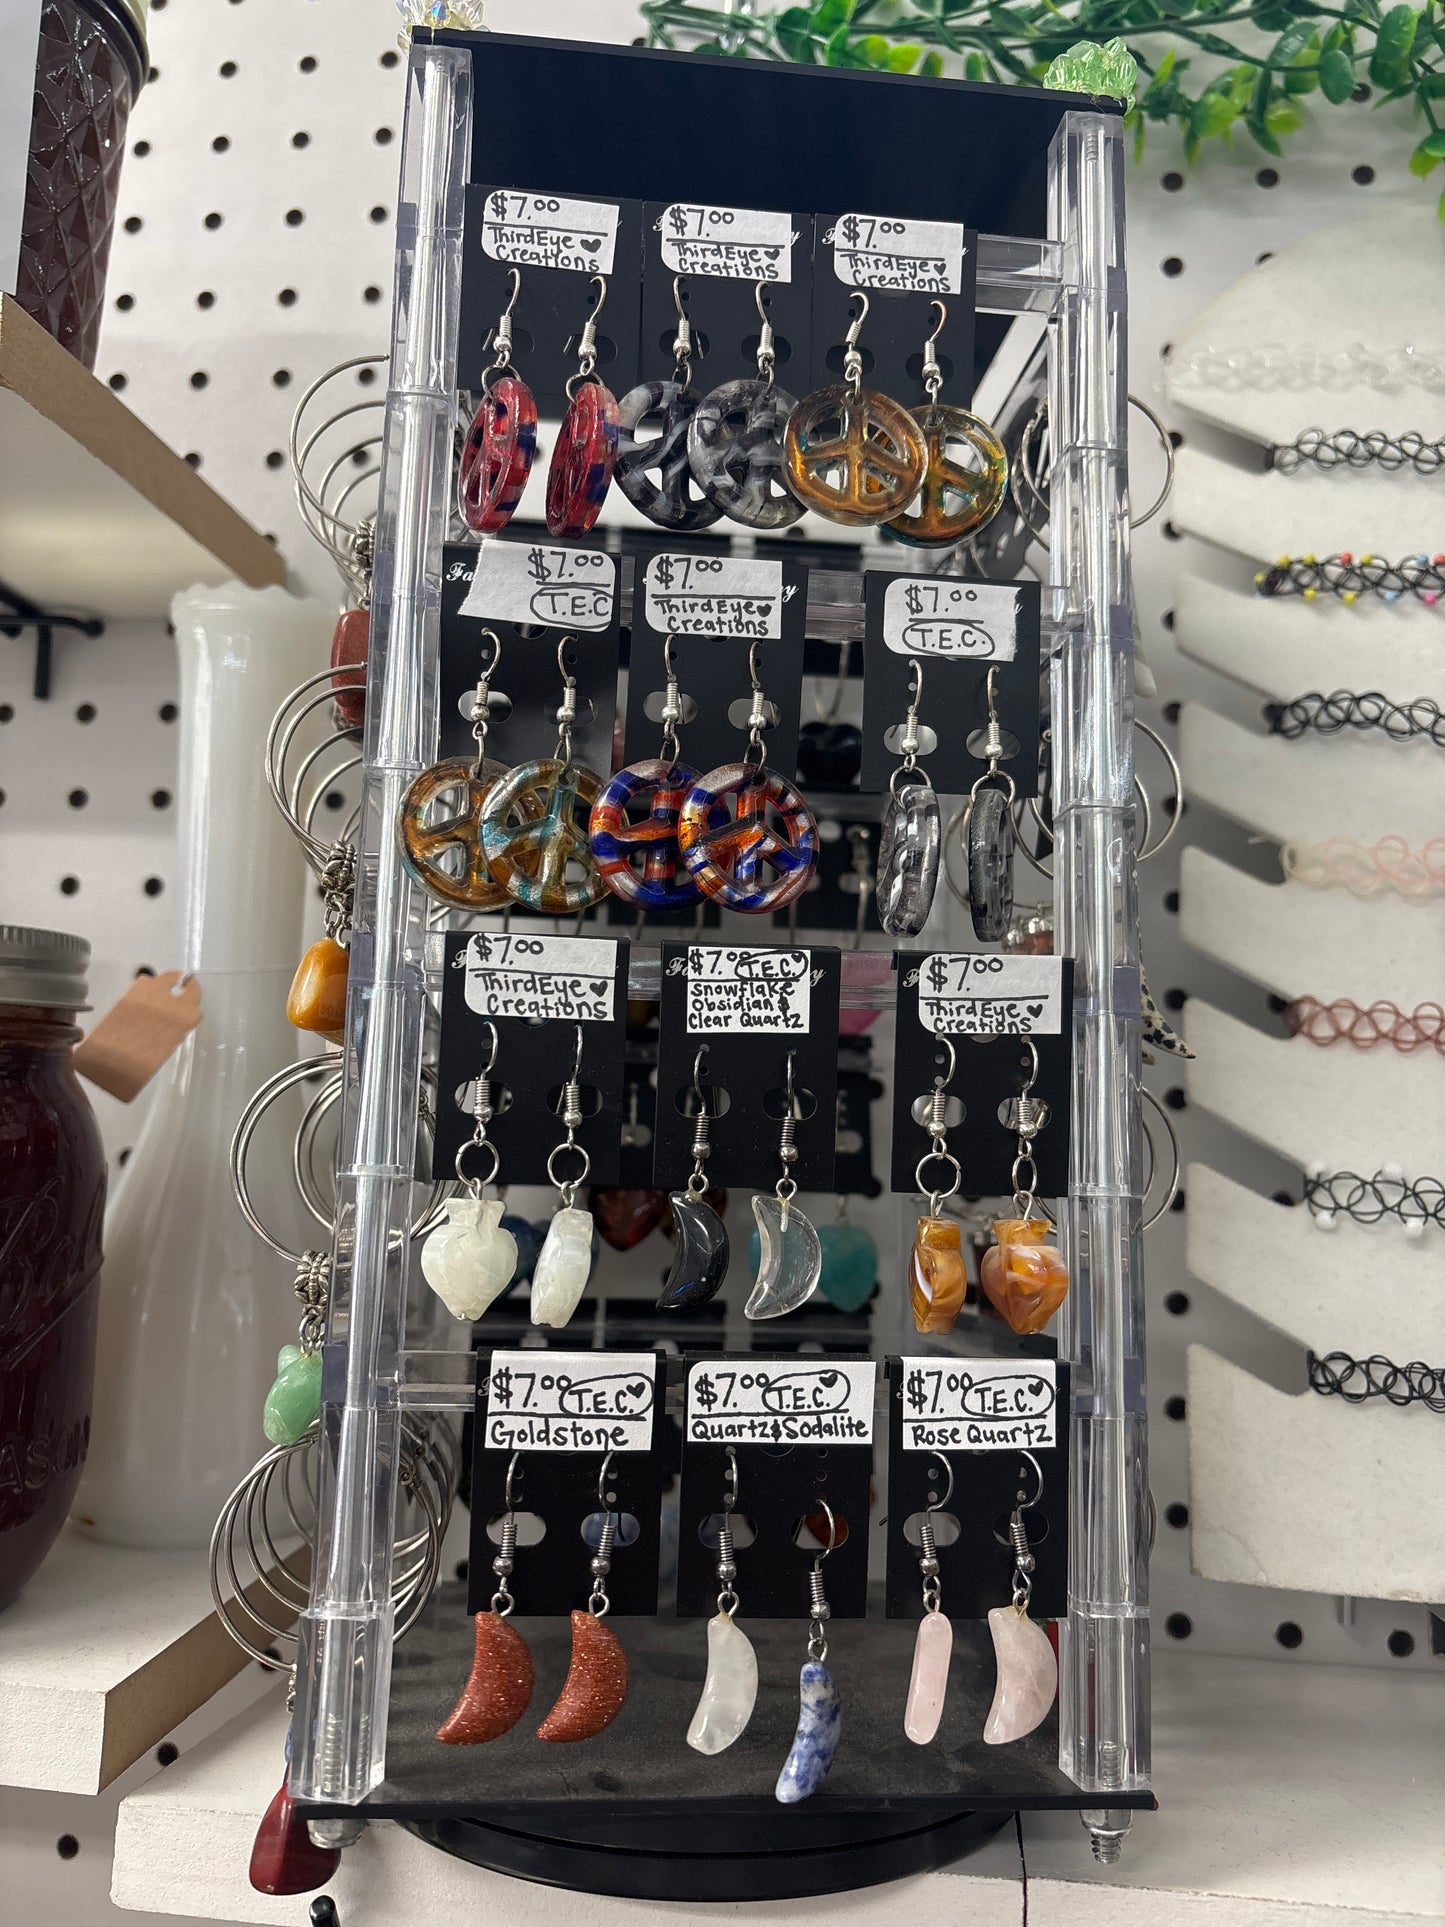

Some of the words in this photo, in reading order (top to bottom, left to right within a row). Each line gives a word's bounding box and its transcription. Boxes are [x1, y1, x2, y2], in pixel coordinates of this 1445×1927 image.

[490, 192, 560, 221] $7.00
[669, 205, 735, 237] $7.00
[842, 215, 906, 249] $7.00
[496, 244, 600, 272] Creations
[678, 257, 779, 279] Creations
[852, 269, 951, 293] Creations
[527, 547, 604, 581] $7.00
[654, 555, 723, 590] $7.00
[904, 584, 978, 615] $7.00
[667, 615, 769, 636] Creations
[910, 627, 986, 649] T.E.C.
[473, 933, 544, 965] $7.00
[688, 948, 750, 975] $7.00
[740, 958, 797, 977] T.E.C.
[926, 956, 1004, 993] $7.00
[487, 993, 609, 1020] Creations
[688, 1012, 732, 1030] Clear
[740, 1012, 804, 1029] Quartz
[933, 1017, 1033, 1034] Creations
[491, 1366, 571, 1409] $7.00
[568, 1388, 635, 1414] T.E.C.
[694, 1372, 770, 1412] $7.00
[766, 1385, 831, 1410] T.E.C.
[906, 1369, 973, 1414] $7.00
[973, 1386, 1033, 1414] T.E.C.
[490, 1417, 629, 1450] Goldstone
[912, 1424, 962, 1447] Rose
[966, 1422, 1053, 1446] Quartz
